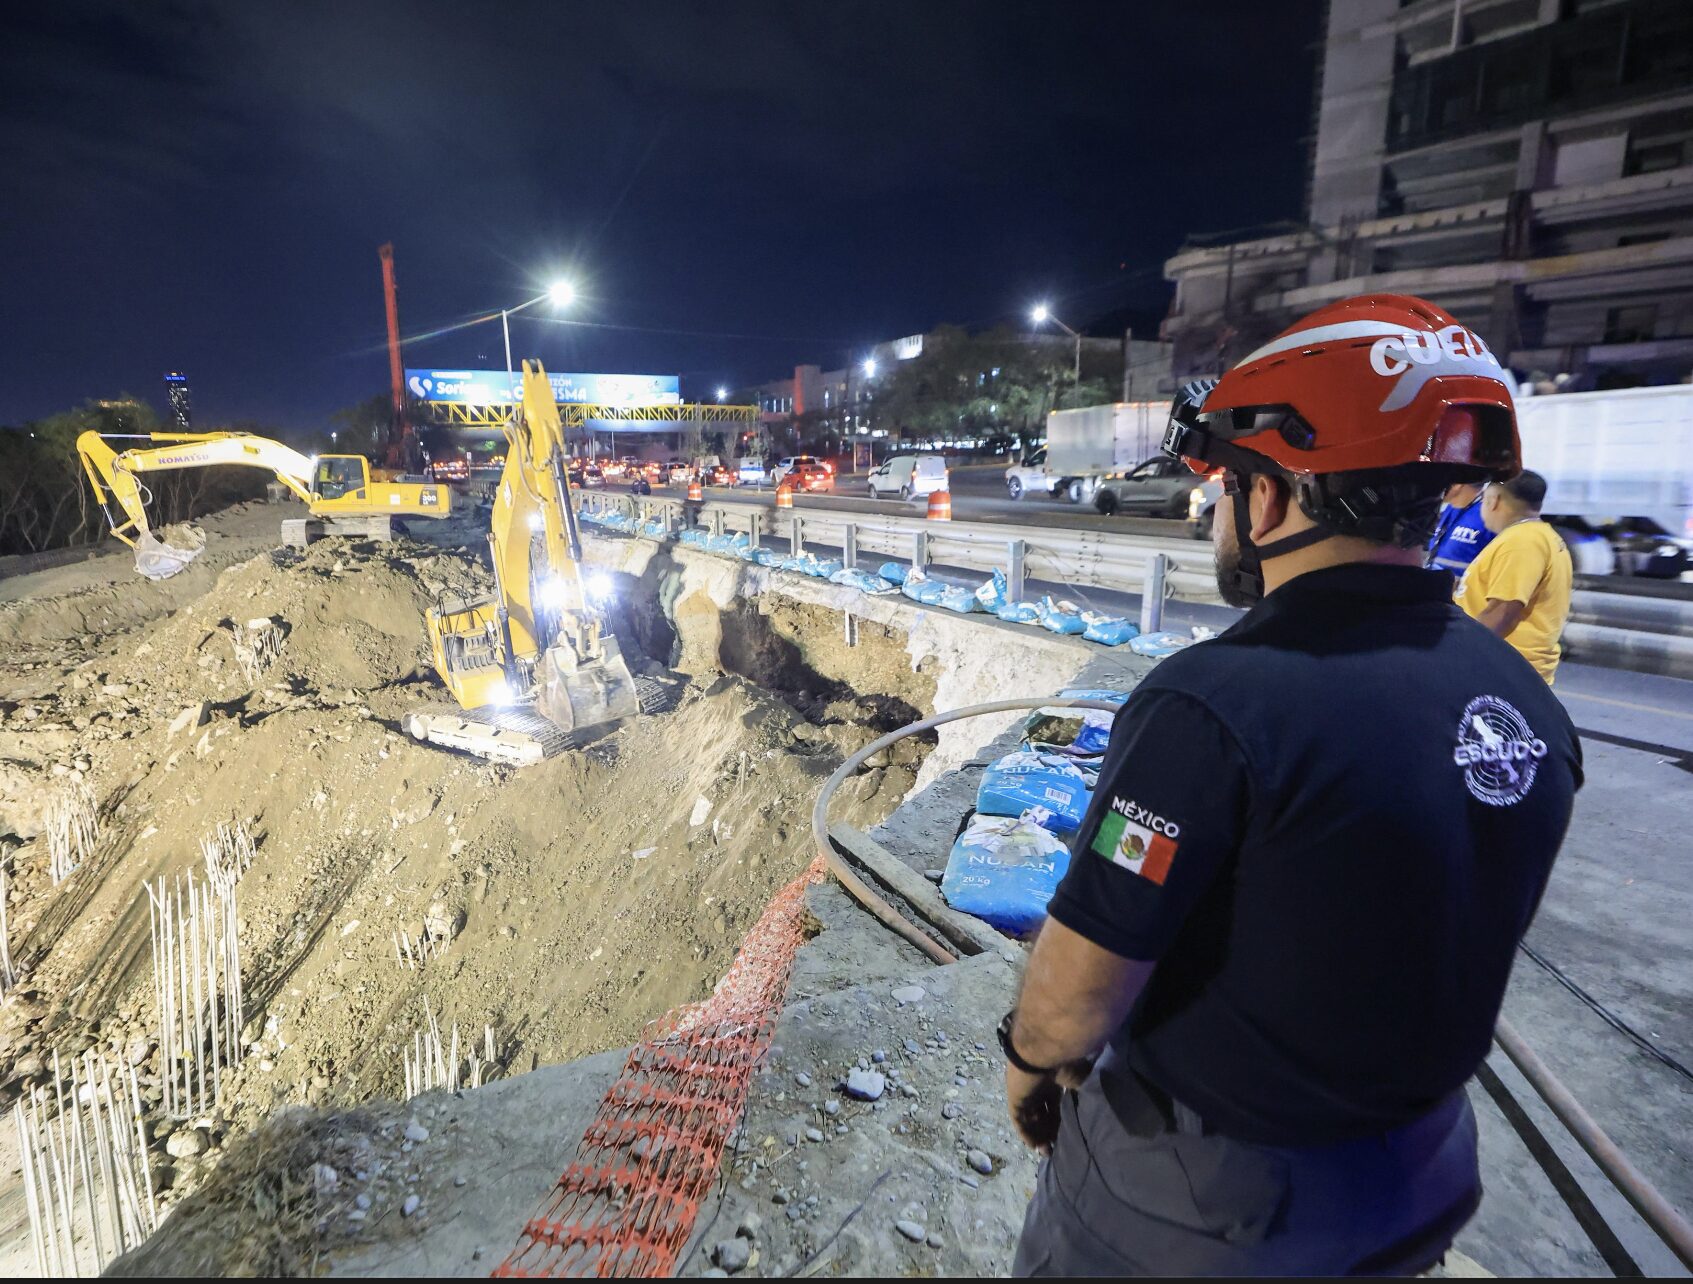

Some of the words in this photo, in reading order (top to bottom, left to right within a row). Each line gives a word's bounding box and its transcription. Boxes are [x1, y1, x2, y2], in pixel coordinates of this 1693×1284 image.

[158, 454, 209, 464] KOMATSU
[1454, 738, 1548, 767] ESCUDO
[1111, 795, 1179, 838] MÉXICO
